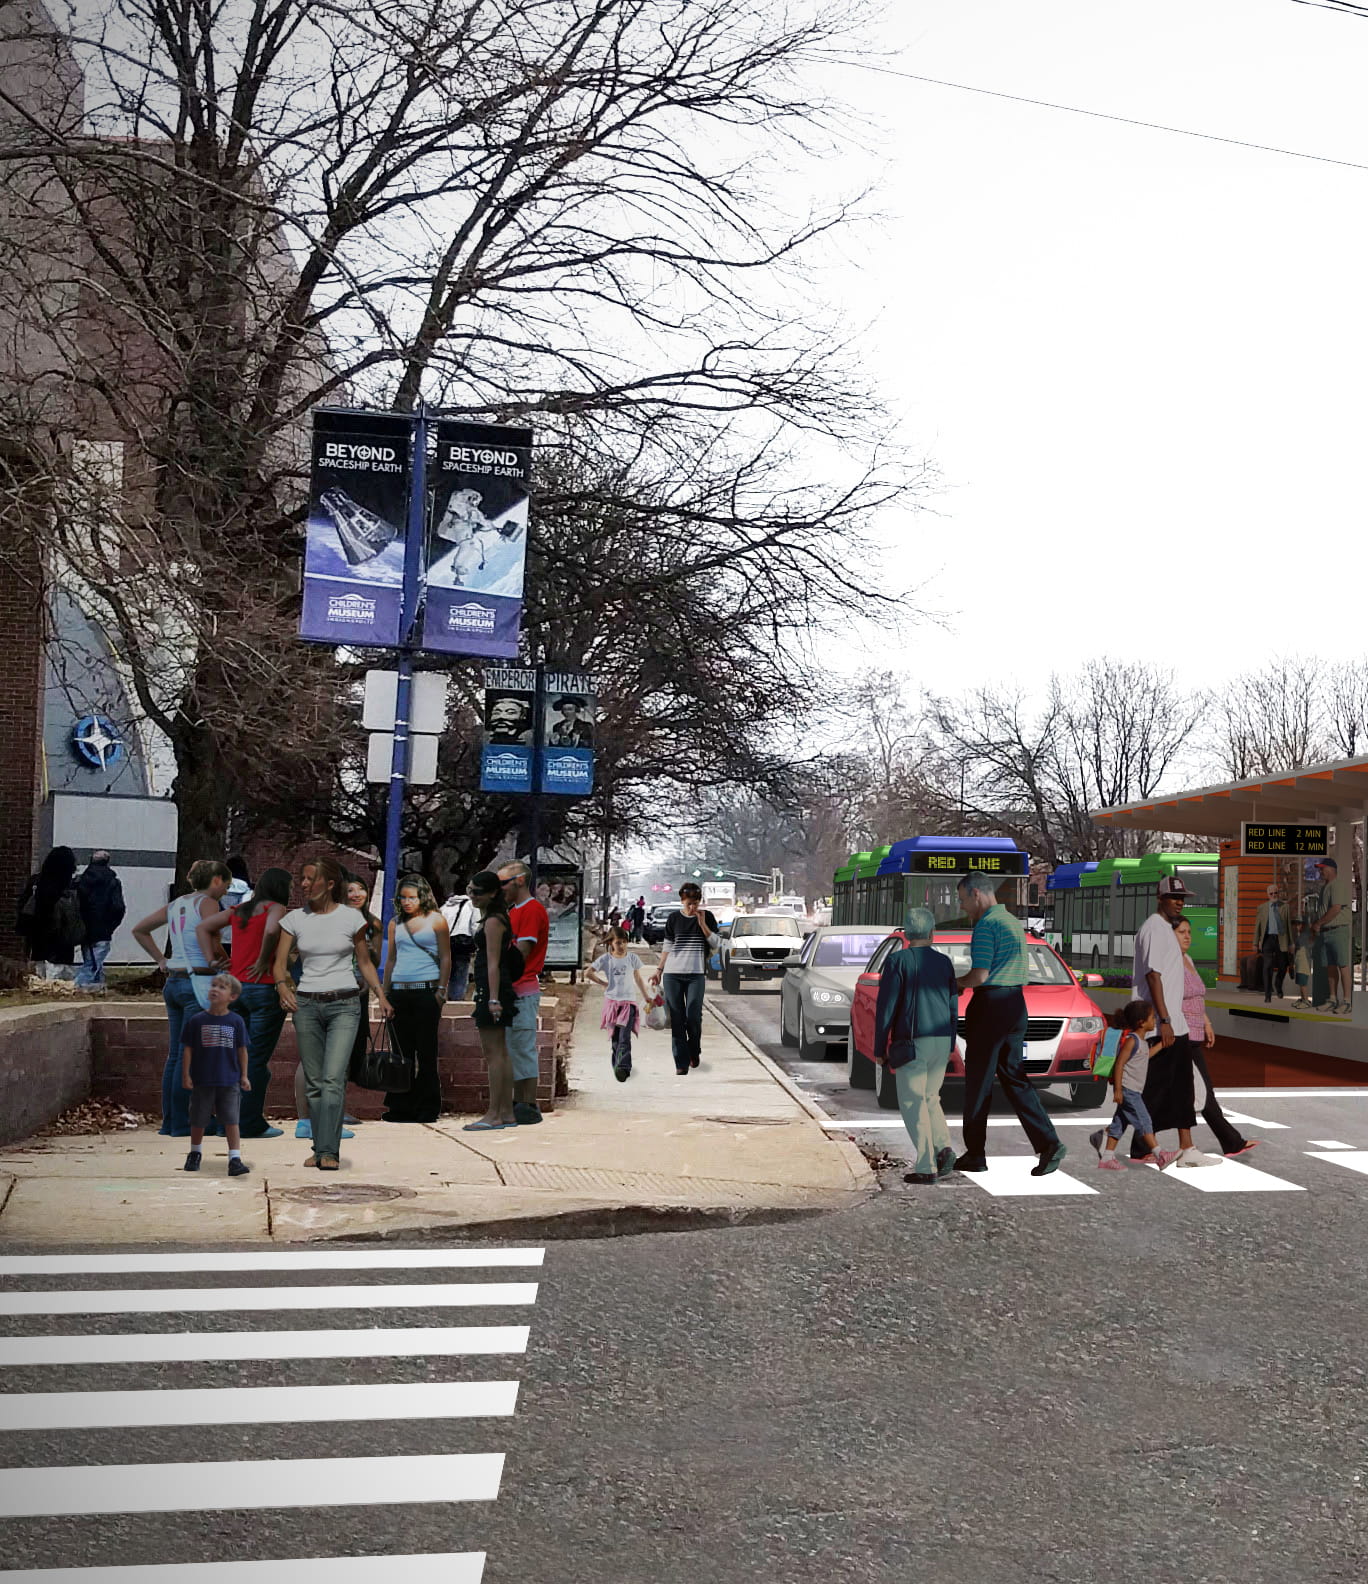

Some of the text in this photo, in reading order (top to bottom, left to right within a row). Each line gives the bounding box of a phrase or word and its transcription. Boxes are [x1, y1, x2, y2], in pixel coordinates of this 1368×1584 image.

[326, 442, 396, 462] BEYOND
[450, 446, 518, 466] BEYOND
[318, 457, 402, 473] SPACESHIP EARTH
[442, 460, 524, 478] SPACESHIP EARTH
[328, 608, 375, 619] MUSEUM
[448, 617, 495, 628] MUSEUM
[486, 668, 535, 691] EMPEROR
[486, 766, 528, 775] MUSEUM
[547, 769, 588, 778] MUSEUM
[1248, 828, 1321, 838] RED LINE 2 MIN
[1248, 841, 1324, 851] RED LINE 12 MIN
[928, 856, 1001, 870] RED LINE
